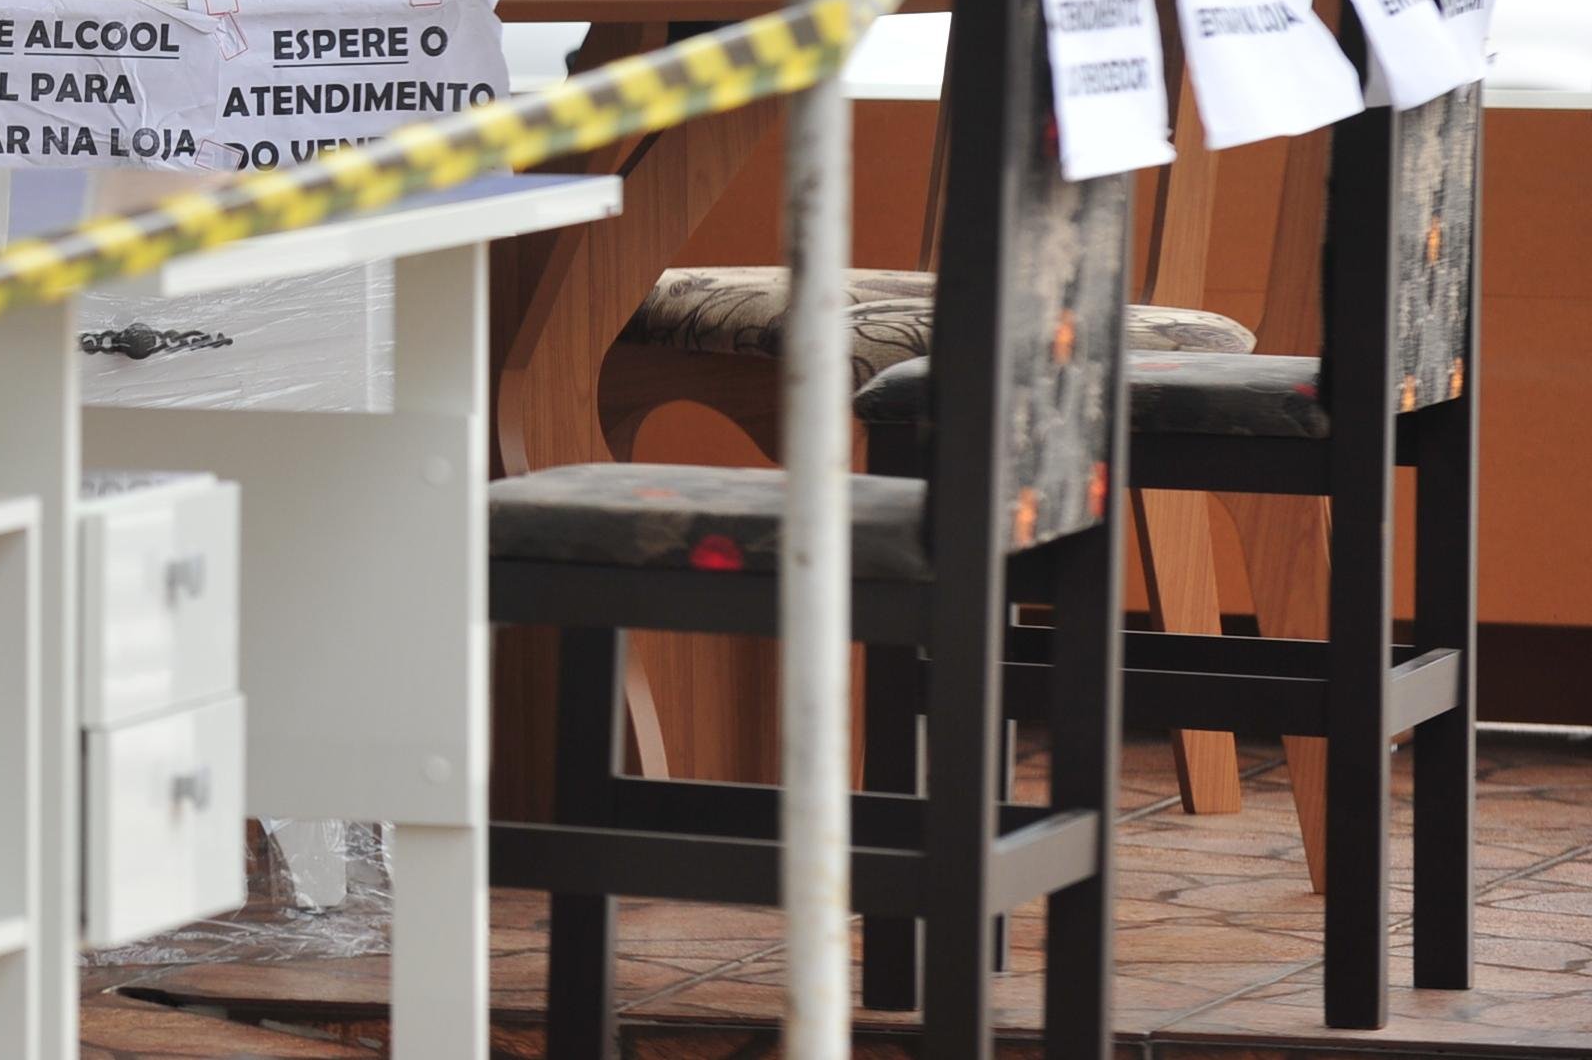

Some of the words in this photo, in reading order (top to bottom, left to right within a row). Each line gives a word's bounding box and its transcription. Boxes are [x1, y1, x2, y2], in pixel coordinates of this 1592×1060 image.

[25, 20, 180, 52] ALCOOL
[273, 26, 409, 60] ESPERE
[420, 26, 448, 57] O
[30, 72, 136, 105] PARA
[222, 81, 496, 118] ATENDIMENTO
[42, 126, 98, 156] NA
[110, 127, 196, 161] LOJA
